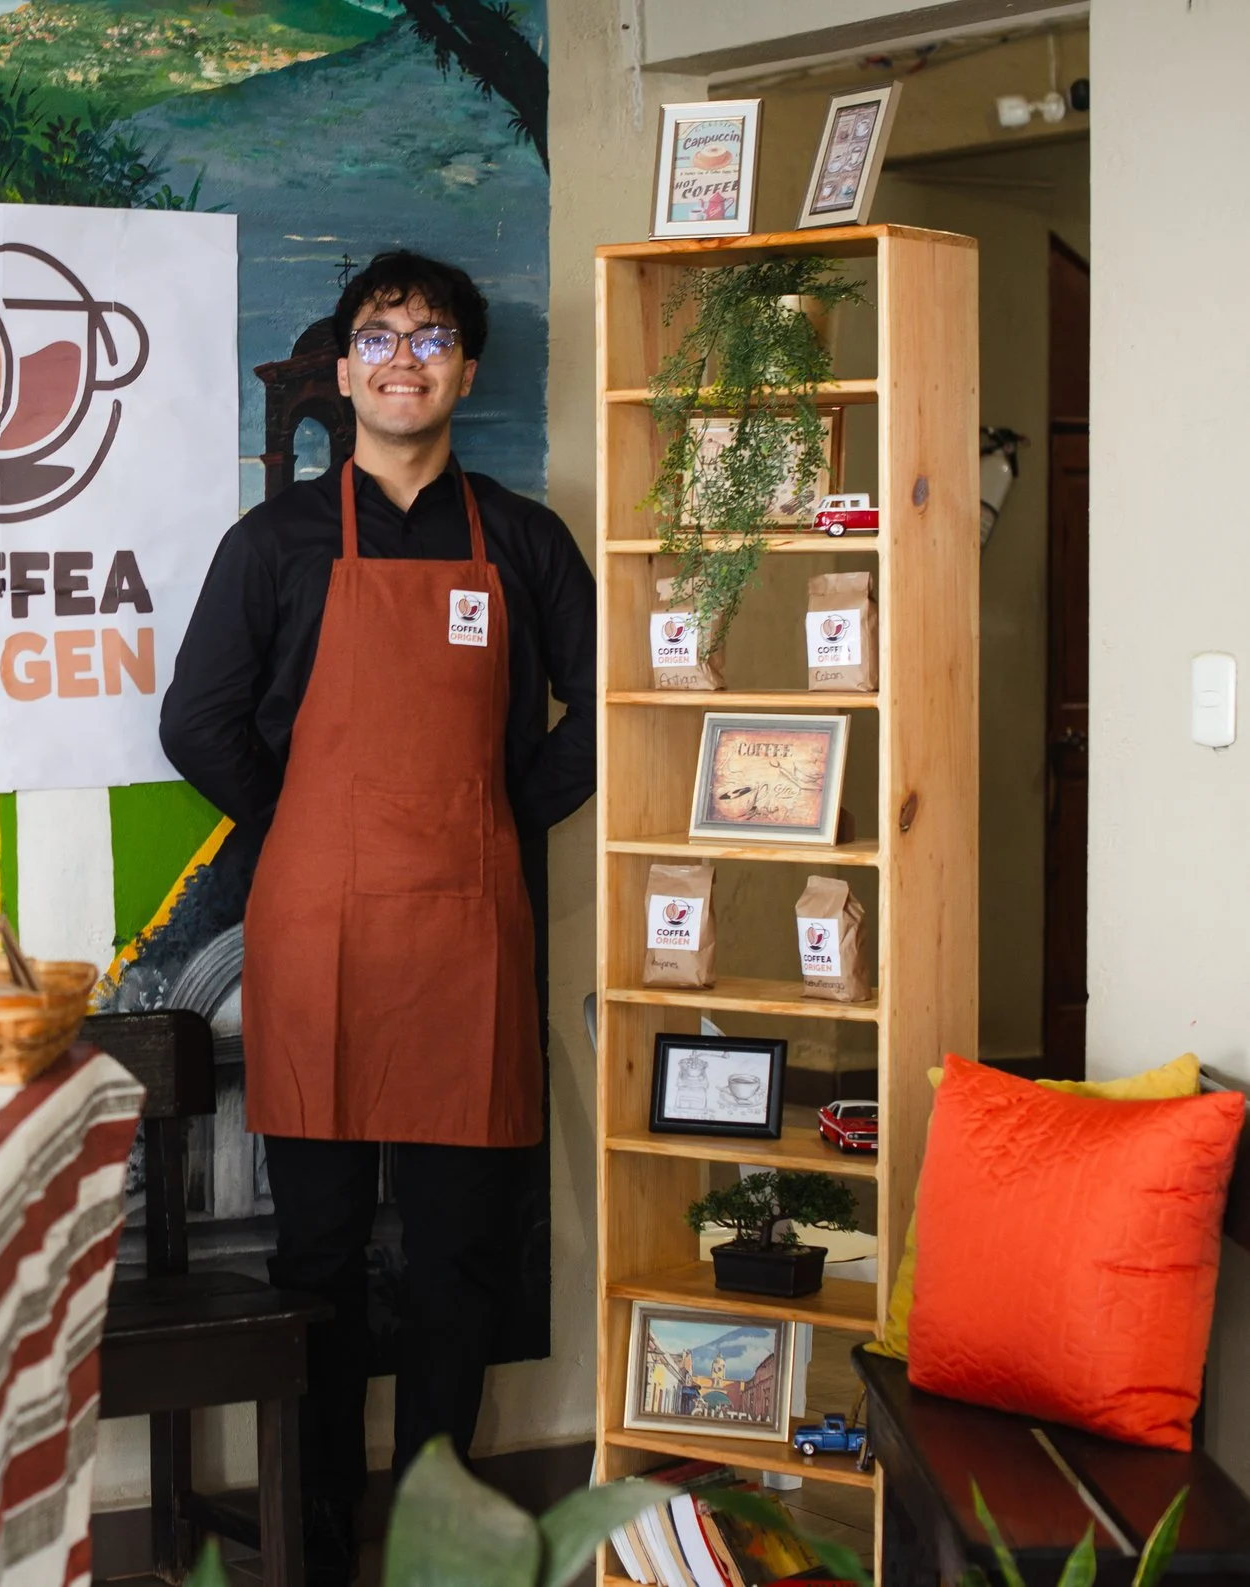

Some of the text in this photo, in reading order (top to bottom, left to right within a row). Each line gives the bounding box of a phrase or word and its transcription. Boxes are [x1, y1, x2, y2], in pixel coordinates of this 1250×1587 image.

[675, 179, 697, 190] HOT
[451, 624, 483, 634] COFFEA
[450, 632, 483, 643] ORIGEN
[658, 647, 689, 655] COFFEA
[658, 656, 690, 664] ORIGEN
[738, 742, 794, 758] COFFEE
[656, 929, 690, 937] COFFEA
[655, 937, 690, 945] ORIGEN
[803, 954, 832, 963] COFFEA
[804, 963, 833, 972] ORIGEN
